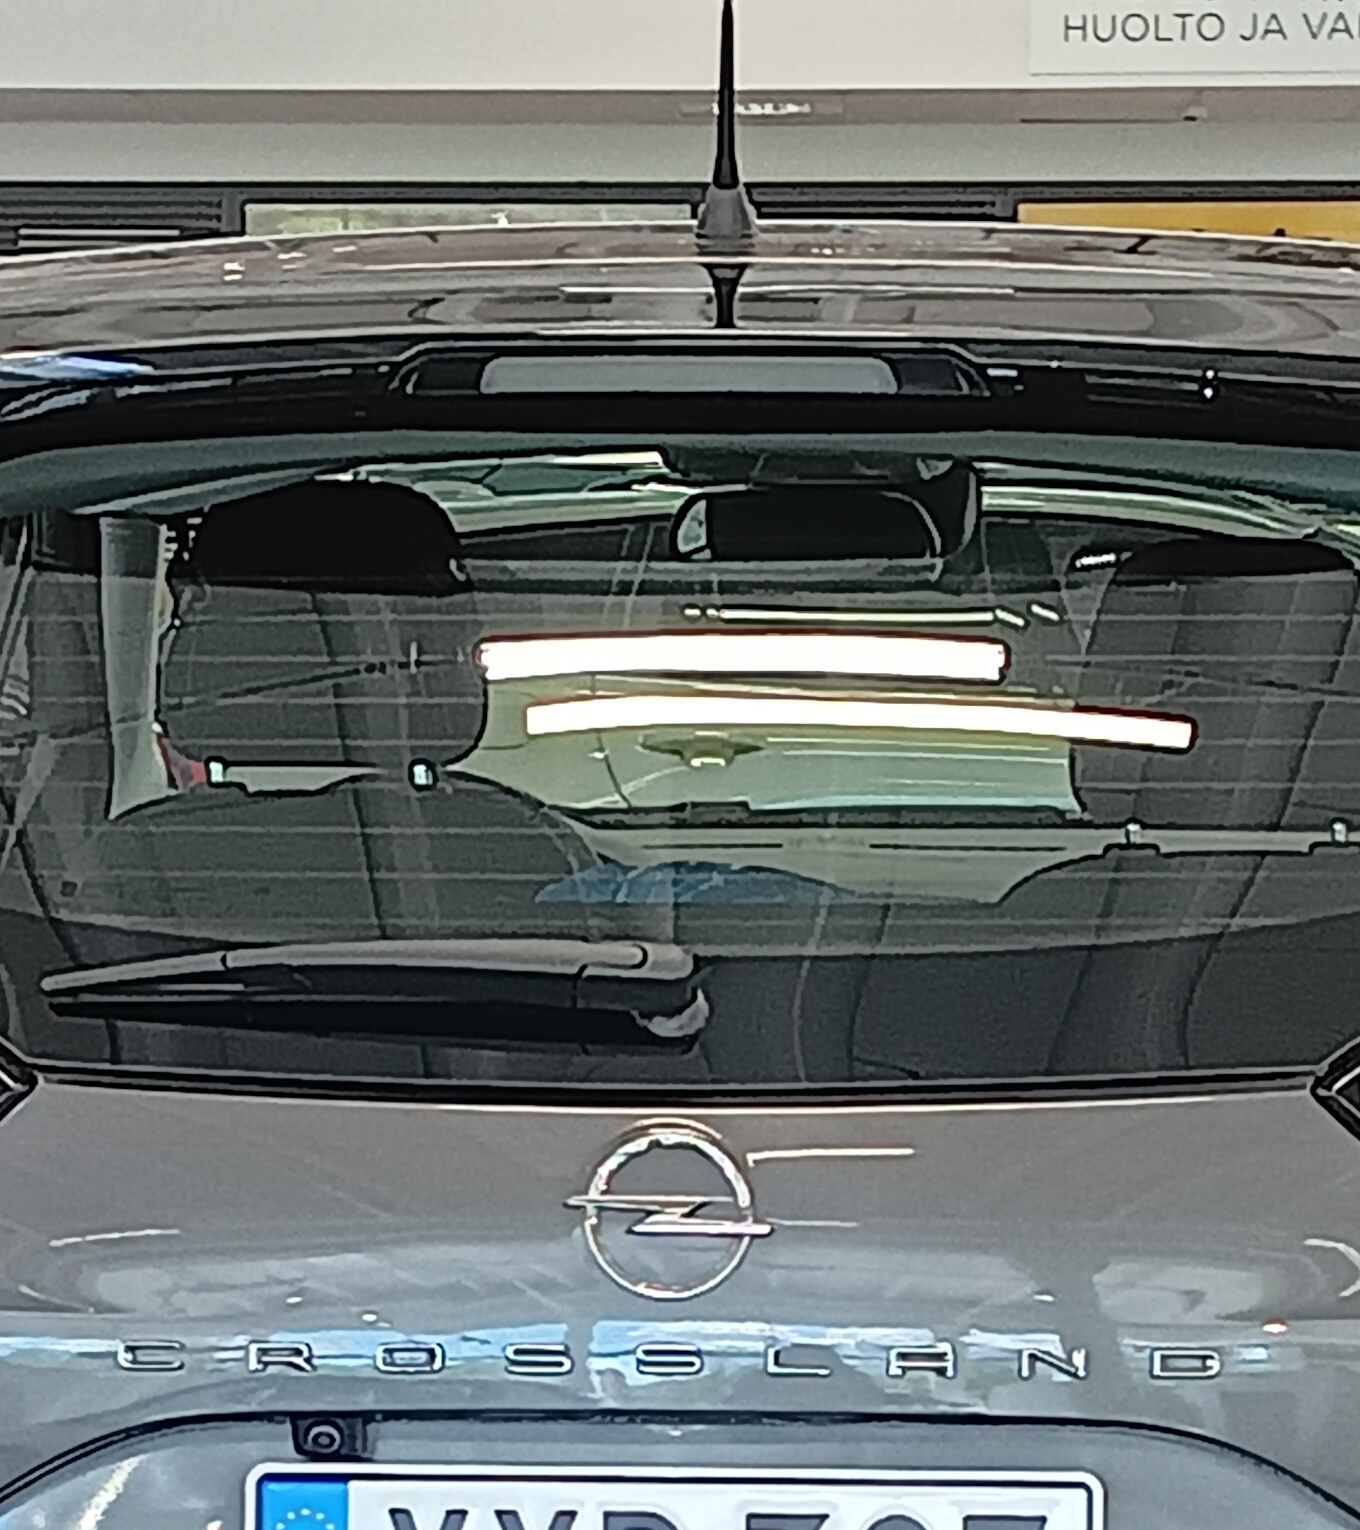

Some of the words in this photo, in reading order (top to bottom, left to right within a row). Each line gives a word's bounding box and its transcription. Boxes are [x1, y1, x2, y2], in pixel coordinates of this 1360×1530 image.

[1062, 12, 1225, 43] HUOLTO
[1238, 12, 1288, 42] JA
[115, 1338, 1223, 1380] CROSSLAND
